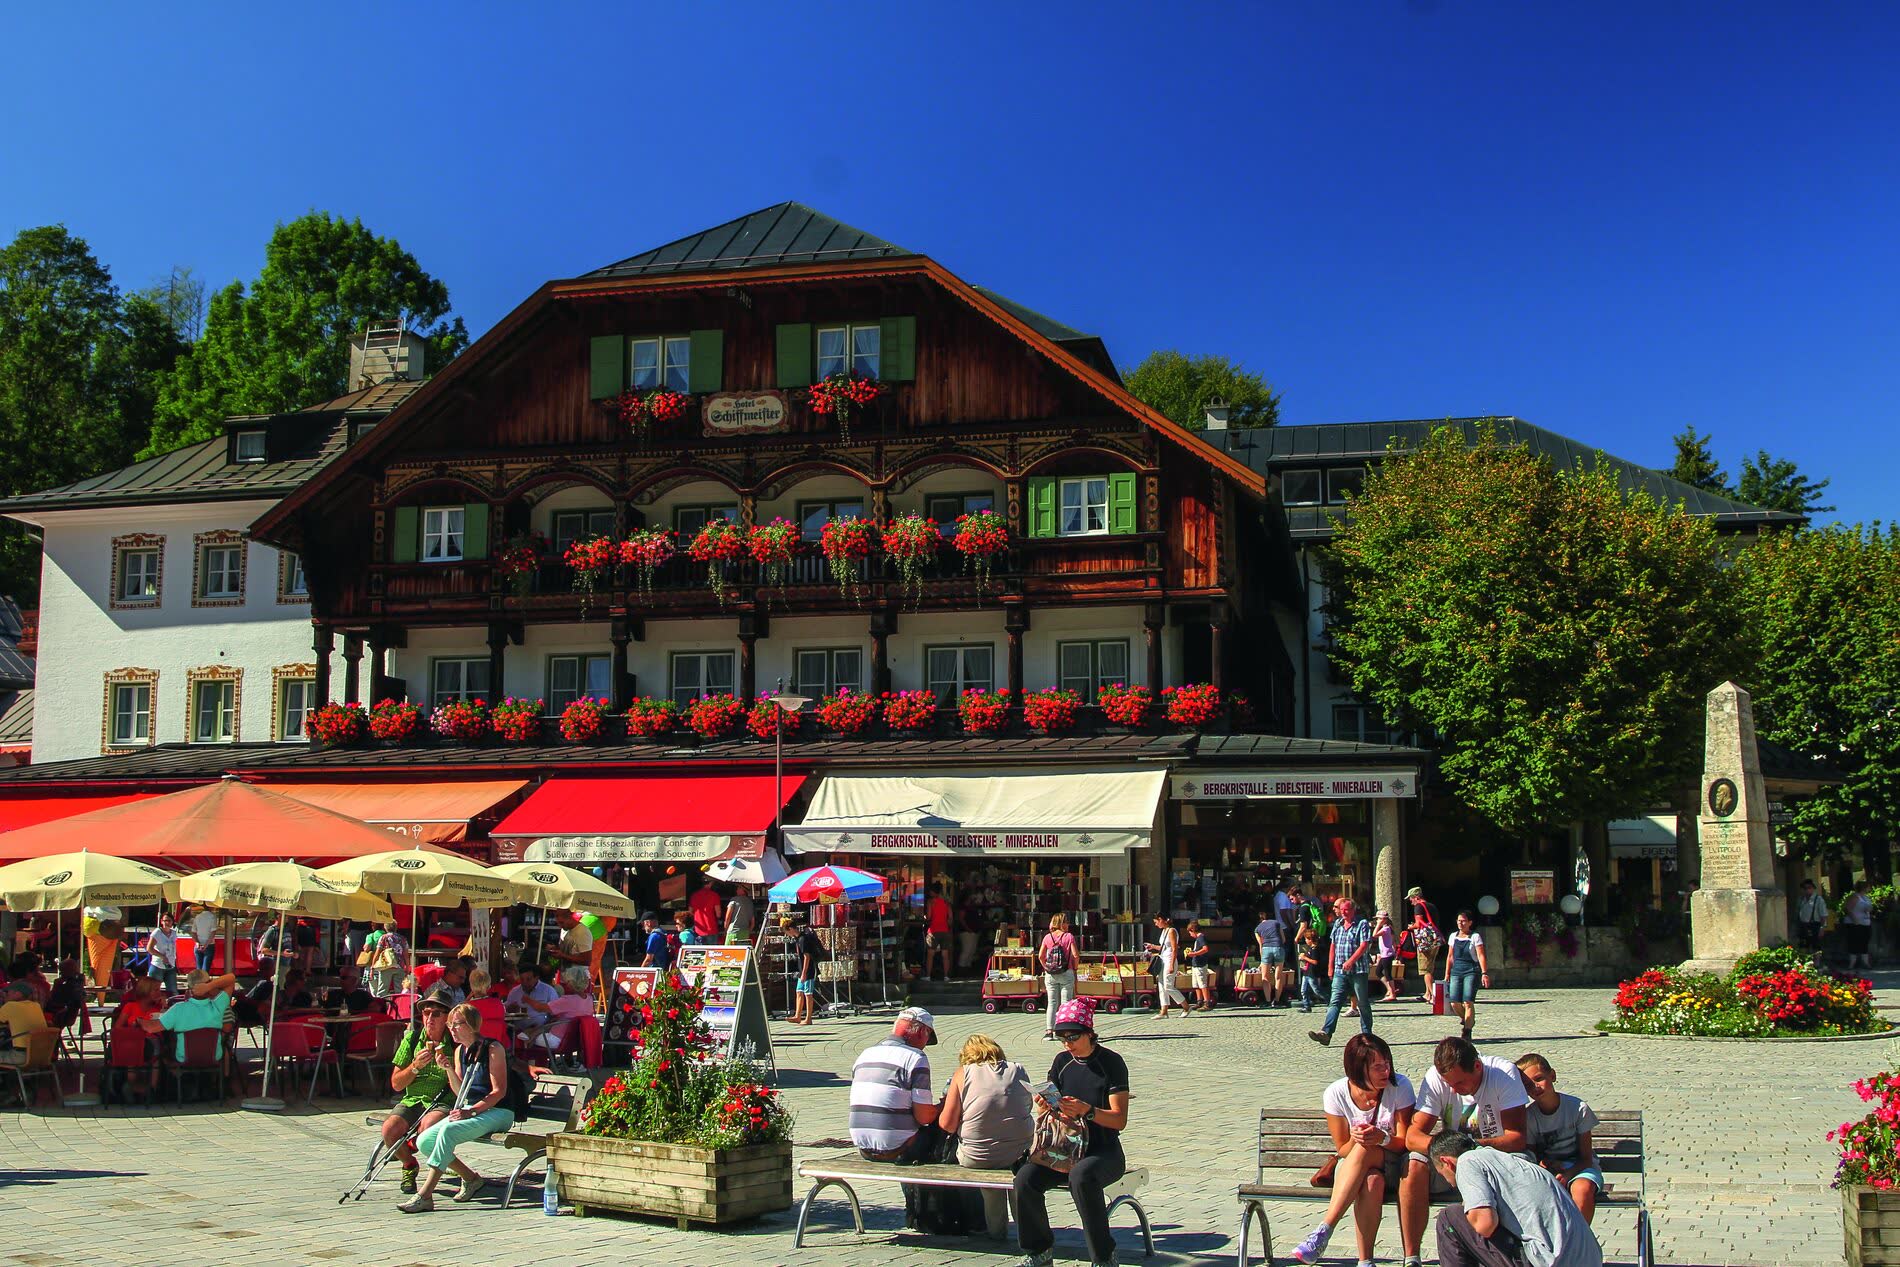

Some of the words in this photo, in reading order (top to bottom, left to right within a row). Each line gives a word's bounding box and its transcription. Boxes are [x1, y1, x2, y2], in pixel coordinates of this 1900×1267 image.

[733, 400, 755, 408] Hotel
[1203, 782, 1268, 795] BERGKRISTALLE
[1275, 782, 1325, 794] EDELSTEINE
[1332, 780, 1383, 794] MINERALIEN
[549, 839, 593, 848] Italienische
[595, 838, 656, 849] Eisspezialitäten
[663, 839, 704, 847] Confiserie
[871, 834, 938, 848] BERGKRISTALLE
[946, 834, 997, 848] EDELSTEINE
[1005, 834, 1059, 848] MINERALIEN
[546, 850, 586, 859] Süßwaren
[593, 850, 618, 859] Kaffee
[620, 850, 627, 858] &
[629, 850, 659, 858] Kuchen
[666, 849, 706, 858] Souvenirs
